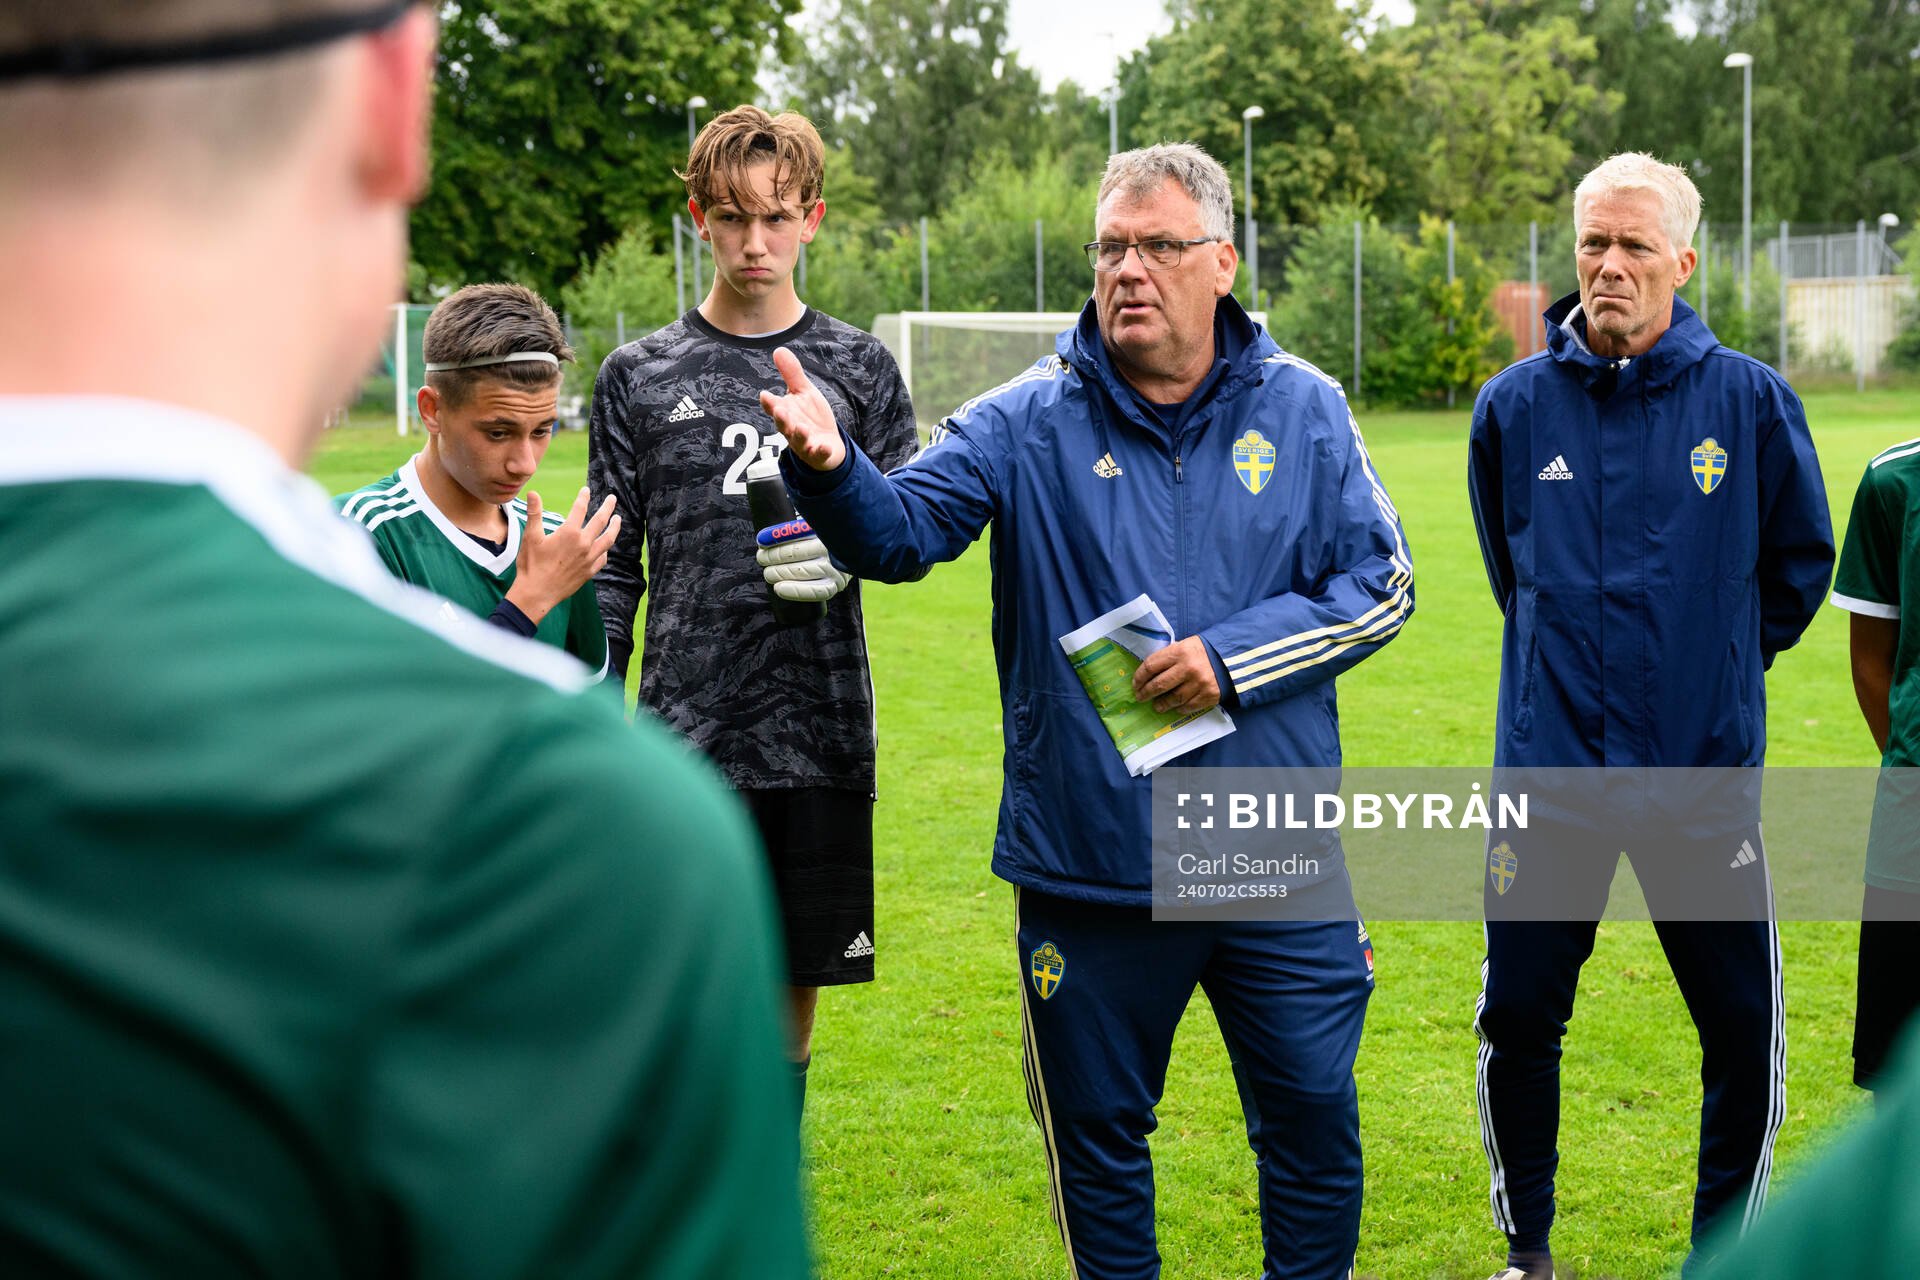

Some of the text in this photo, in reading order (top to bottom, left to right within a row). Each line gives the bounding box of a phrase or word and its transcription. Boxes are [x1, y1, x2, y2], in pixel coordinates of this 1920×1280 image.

[668, 408, 705, 423] adidas
[1538, 470, 1574, 481] adidas
[772, 521, 812, 539] adida
